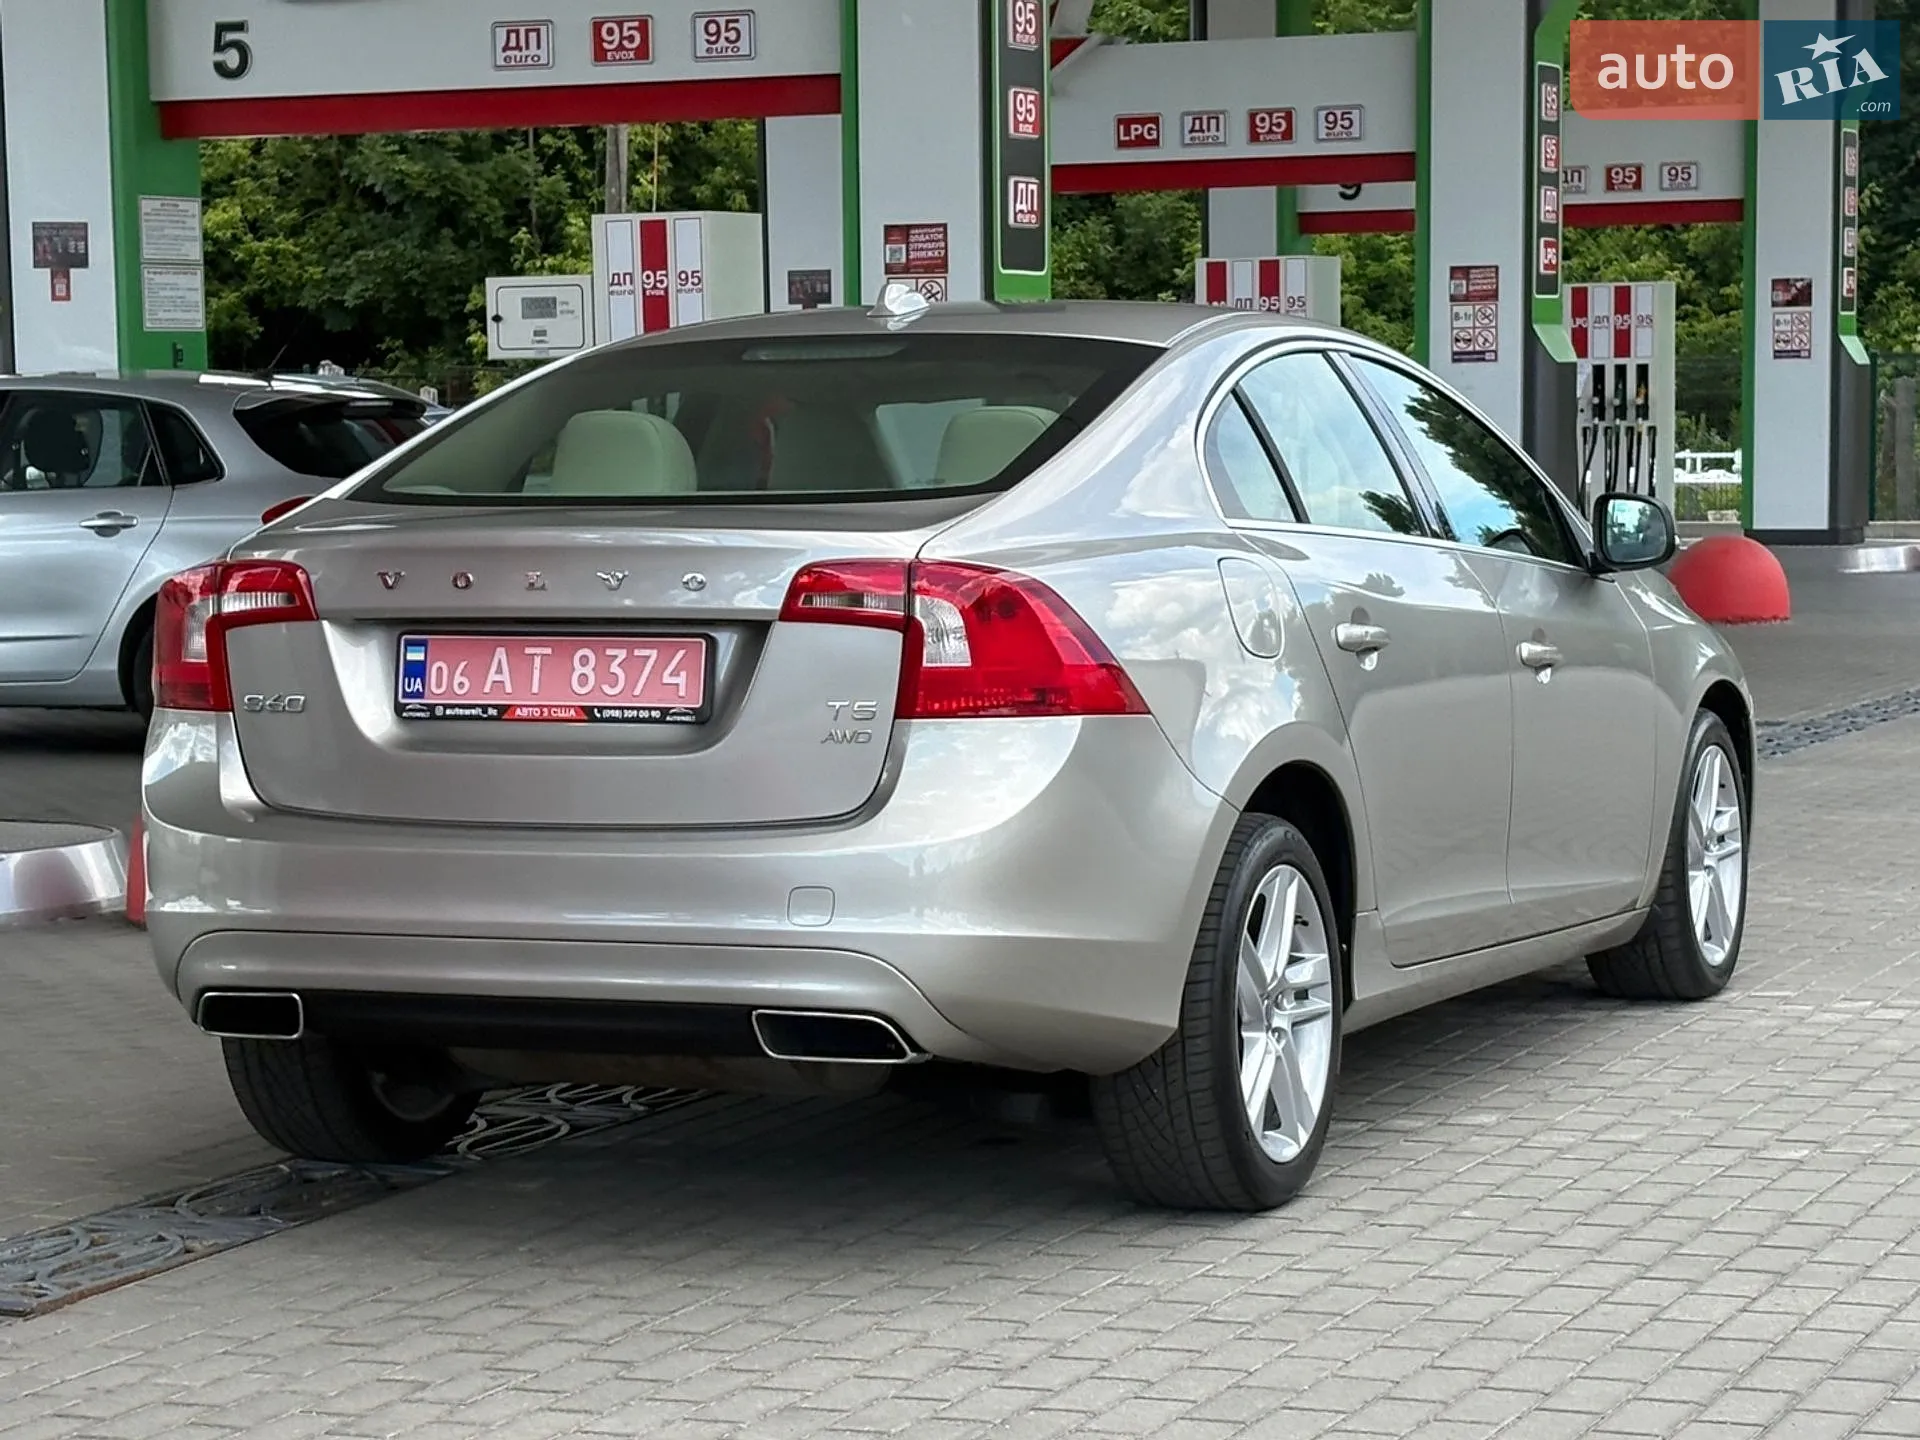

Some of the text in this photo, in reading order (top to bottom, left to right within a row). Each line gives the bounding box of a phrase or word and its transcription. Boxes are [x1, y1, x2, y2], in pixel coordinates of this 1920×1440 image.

[1015, 1, 1036, 34] 95
[501, 28, 541, 52] ДП
[600, 21, 641, 50] 95
[703, 19, 741, 45] 95
[1015, 33, 1036, 44] euro
[213, 20, 253, 80] 5
[606, 51, 636, 60] EVOX
[705, 45, 740, 54] euro
[503, 53, 541, 64] euro
[1016, 93, 1036, 123] 95
[1188, 115, 1220, 134] ДП
[1255, 112, 1287, 133] 95
[1324, 111, 1353, 131] 95
[1119, 123, 1158, 141] LPG
[1189, 134, 1220, 142] euro
[1611, 167, 1637, 184] 95
[1667, 166, 1692, 182] 95
[1015, 183, 1038, 213] ДП
[1016, 213, 1037, 223] euro
[610, 272, 633, 287] ДП
[643, 270, 668, 288] 95
[678, 270, 702, 287] 95
[609, 287, 634, 296] euro
[1260, 296, 1280, 311] 95
[1287, 296, 1306, 308] 95
[1614, 314, 1631, 326] 95
[1637, 314, 1653, 325] 95
[376, 571, 707, 591] VOLVO
[430, 661, 470, 695] 06
[571, 647, 687, 697] 8374
[404, 678, 423, 693] UA
[243, 693, 306, 713] S60
[826, 700, 878, 721] T5
[515, 707, 540, 717] АВТО
[551, 707, 576, 717] США
[820, 729, 873, 744] AWD
